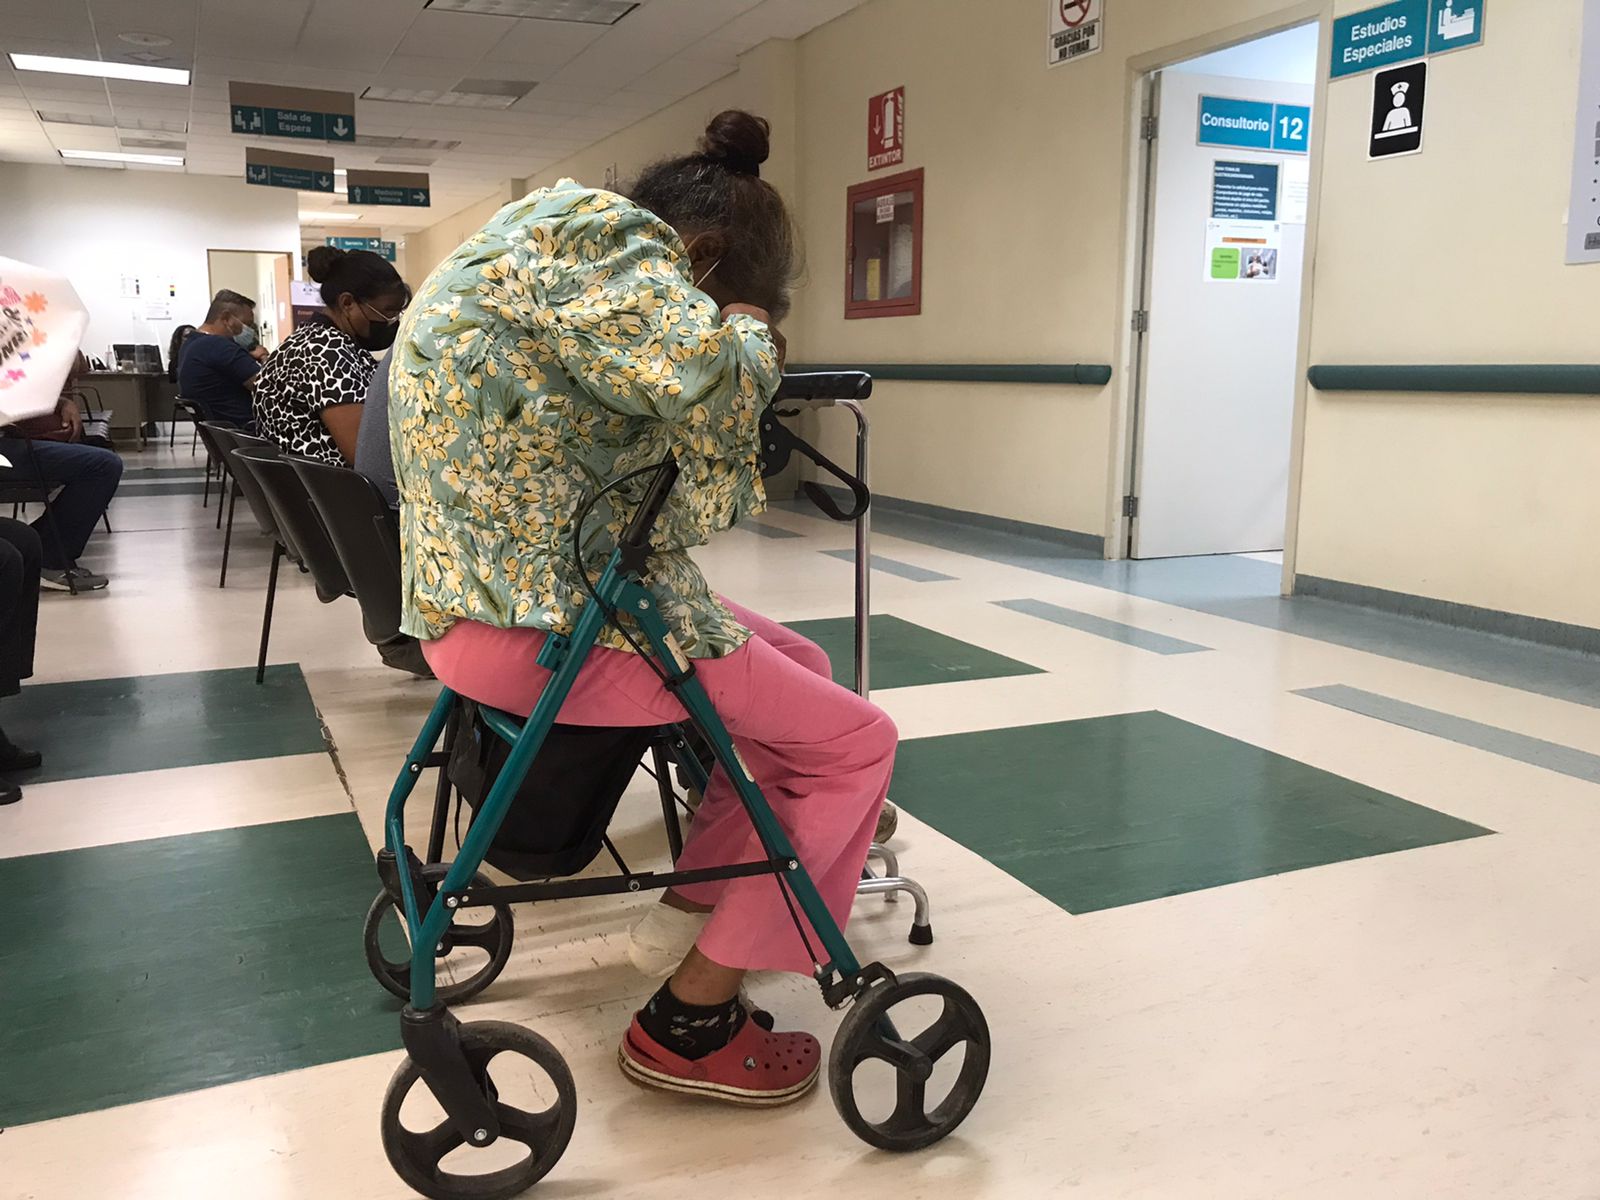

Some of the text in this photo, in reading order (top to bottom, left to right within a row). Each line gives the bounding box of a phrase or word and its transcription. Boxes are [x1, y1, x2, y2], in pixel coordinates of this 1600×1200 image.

[1054, 24, 1095, 49] GRACIAS POR
[1351, 15, 1407, 41] Estudios
[1059, 39, 1090, 59] NO FUMAR
[1343, 35, 1412, 63] Especiales
[277, 111, 311, 122] Sala de
[279, 121, 311, 132] Espera
[1202, 112, 1304, 140] Consultorio 12
[869, 148, 902, 168] EXTINTOR
